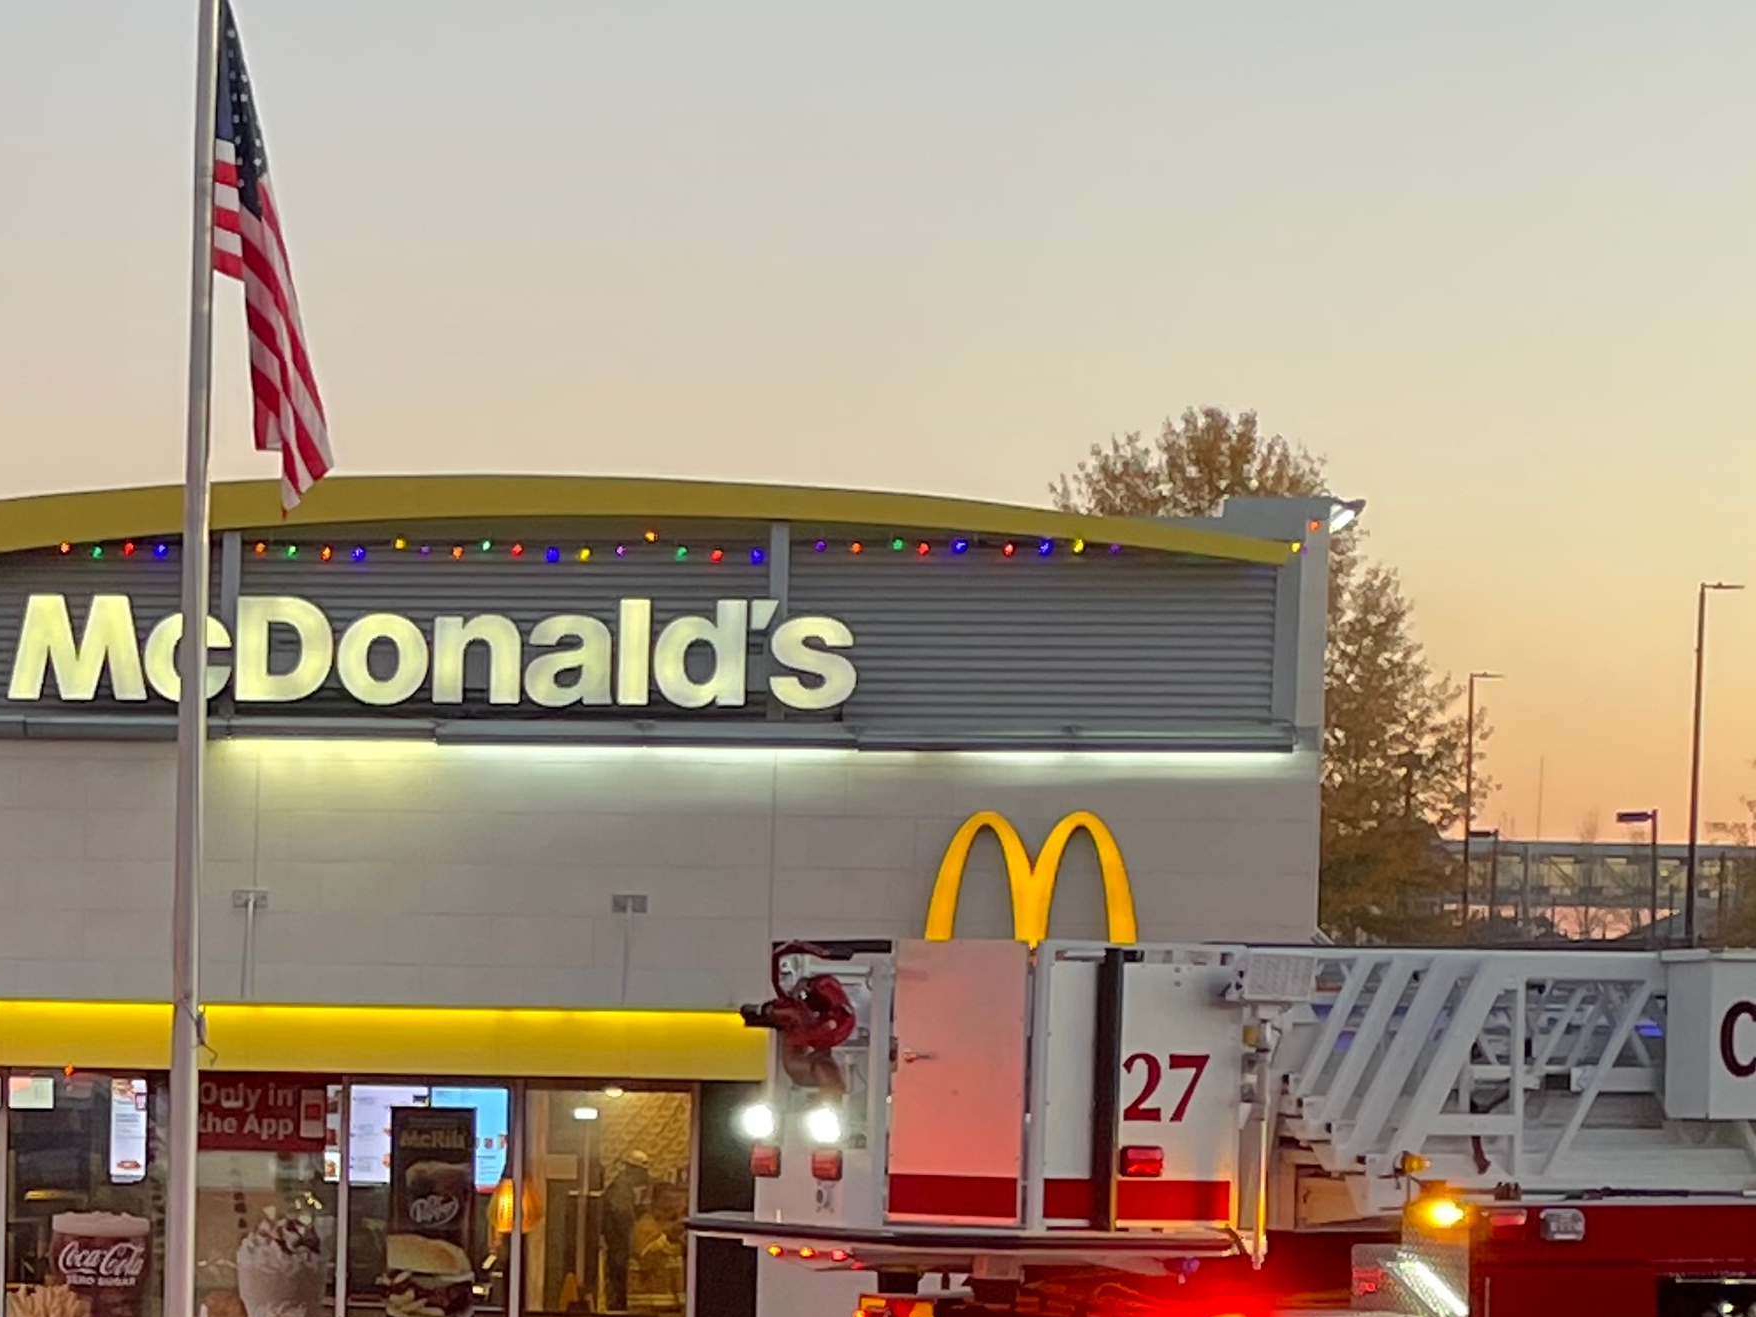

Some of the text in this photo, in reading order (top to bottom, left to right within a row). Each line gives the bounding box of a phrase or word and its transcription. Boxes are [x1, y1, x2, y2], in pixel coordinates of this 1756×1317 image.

[8, 594, 858, 711] McDonald's
[199, 1081, 294, 1112] Only in
[1121, 1052, 1211, 1123] 27
[242, 1113, 295, 1141] App
[58, 1241, 145, 1276] Coca-Cola
